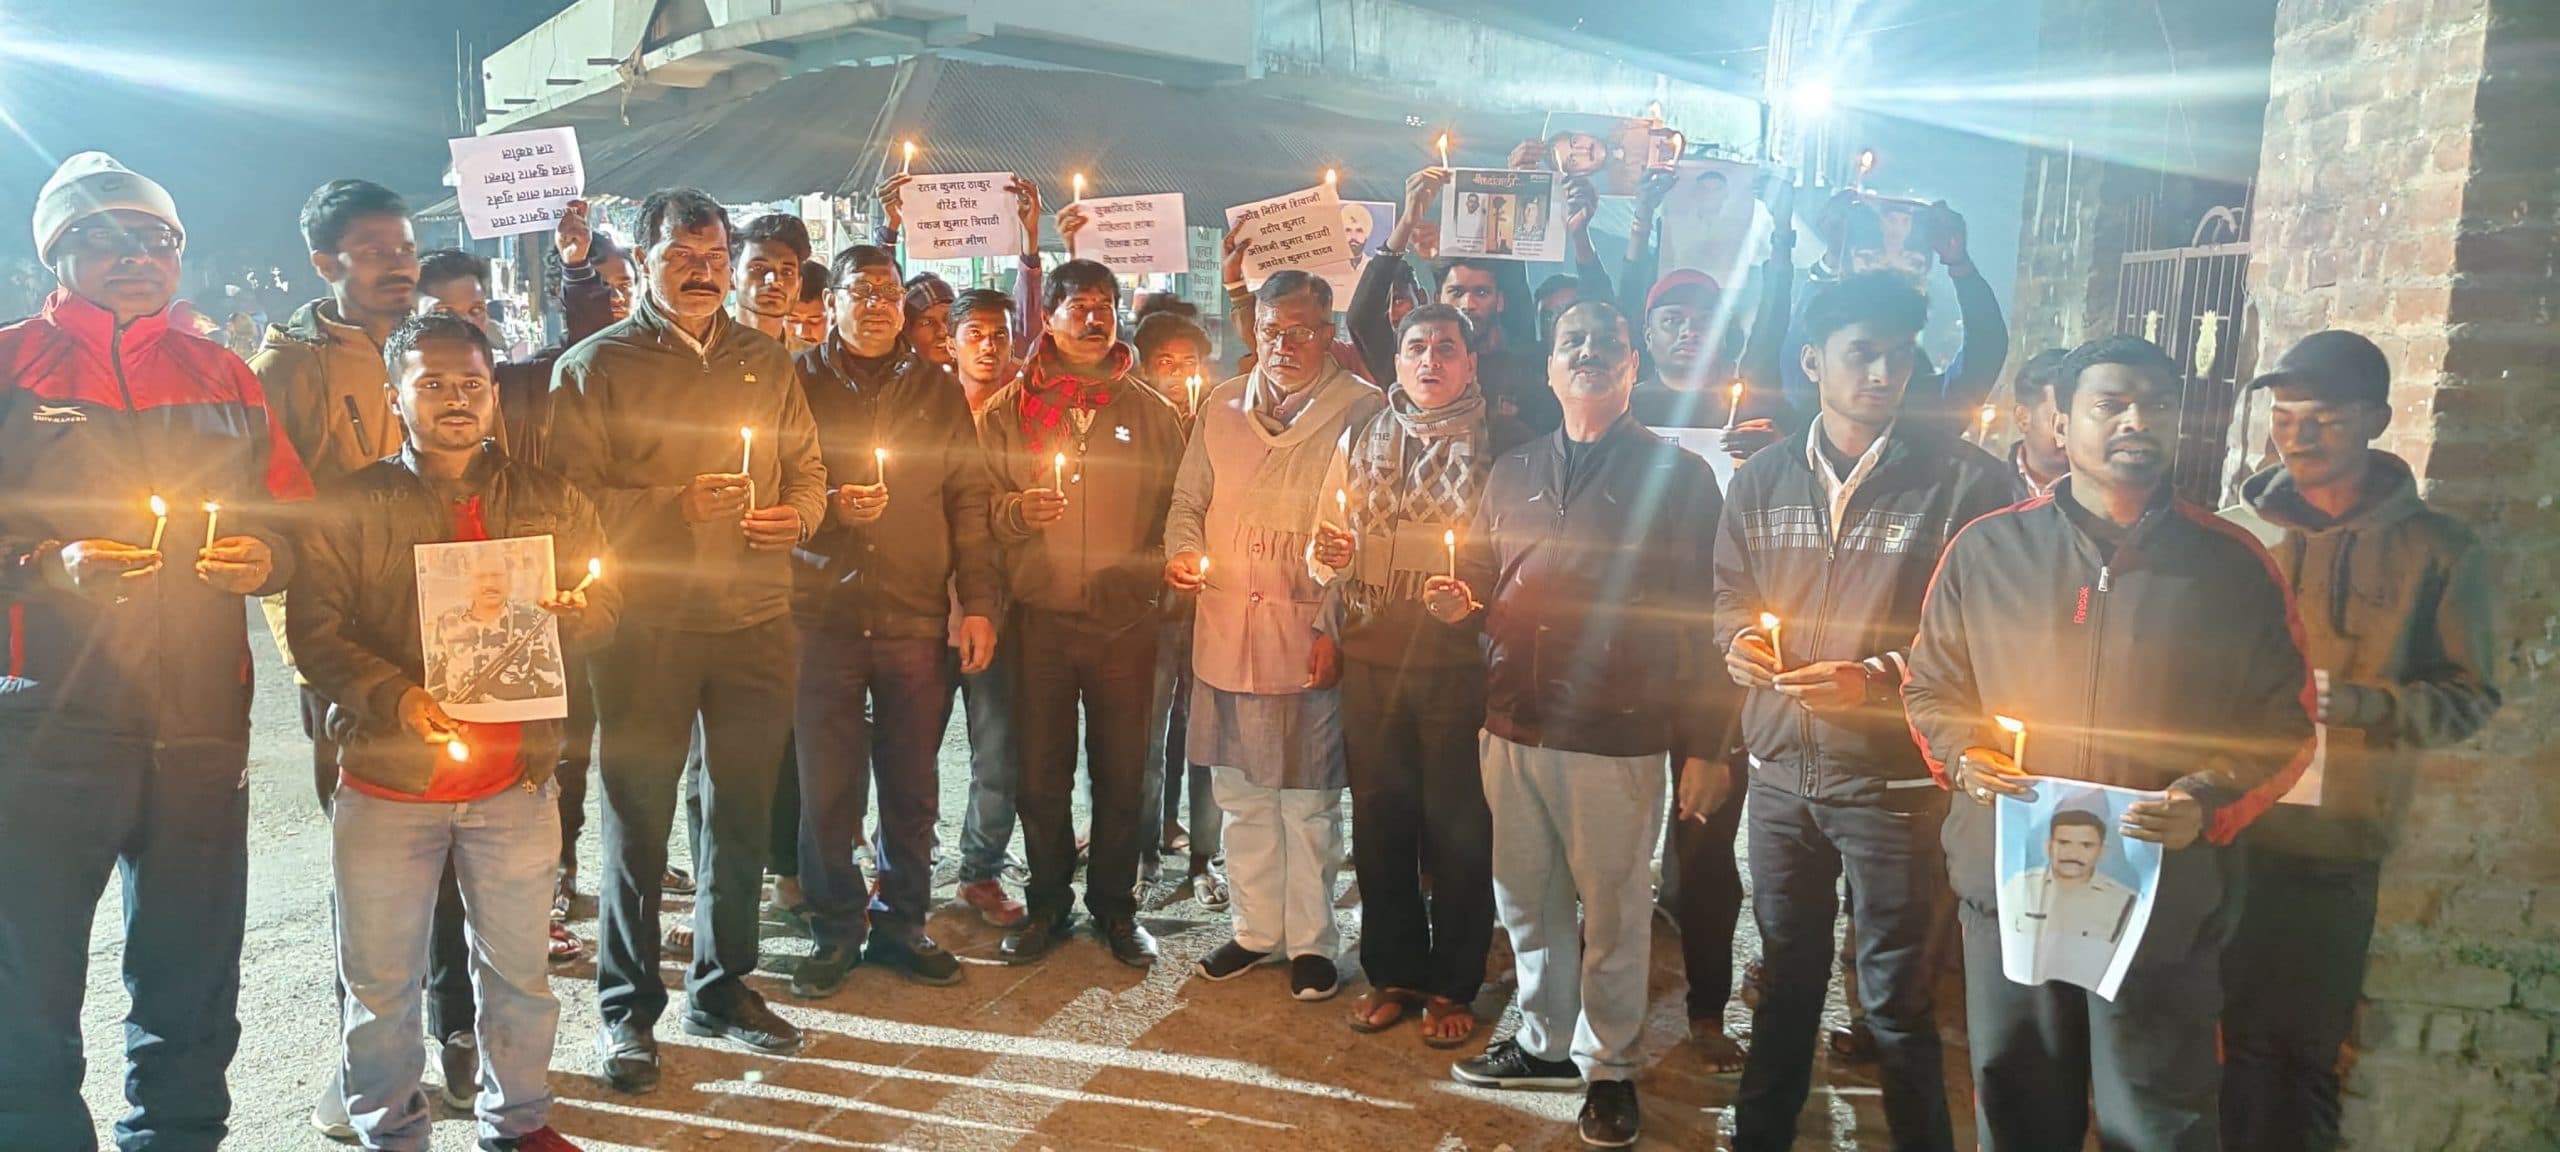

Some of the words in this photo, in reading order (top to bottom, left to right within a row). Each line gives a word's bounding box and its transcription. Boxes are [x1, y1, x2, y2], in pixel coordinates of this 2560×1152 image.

[502, 147, 534, 161] वकील
[535, 144, 554, 154] राम
[484, 171, 515, 184] सिन्हा
[518, 164, 549, 180] कुमार
[917, 182, 938, 193] रतन
[939, 180, 966, 194] कुमार
[967, 179, 992, 192] ठाकुर
[516, 189, 540, 201] लाल
[959, 197, 978, 210] सिंह
[1260, 202, 1287, 217] नितिन
[1289, 192, 1320, 207] शिवाजी
[491, 215, 517, 228] रावत
[917, 219, 941, 230] पंकज
[942, 218, 969, 232] कुमार
[970, 214, 1000, 226] त्रिपाठी
[1260, 222, 1280, 236] प्रदीप
[1282, 216, 1308, 232] कुमार
[933, 237, 962, 248] हेमराज
[966, 233, 987, 245] मीणा
[1279, 235, 1305, 250] कुमार
[1287, 250, 1311, 265] कुमार
